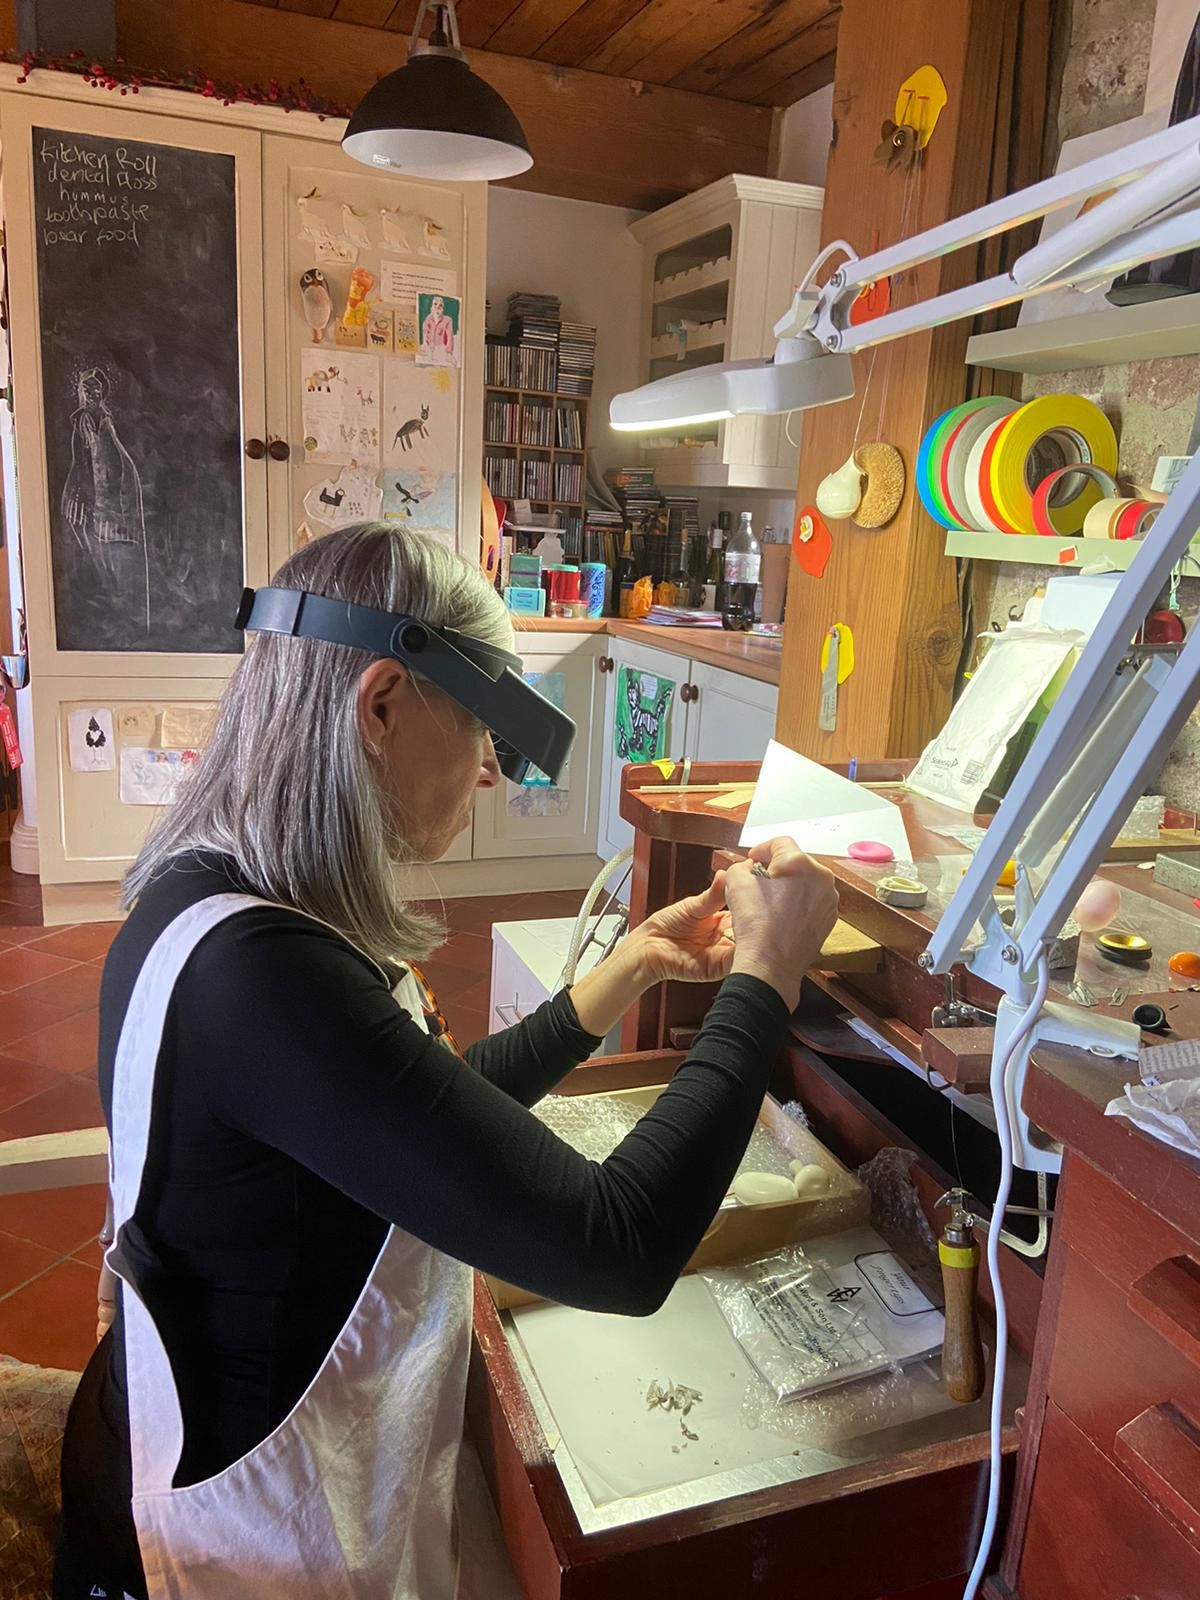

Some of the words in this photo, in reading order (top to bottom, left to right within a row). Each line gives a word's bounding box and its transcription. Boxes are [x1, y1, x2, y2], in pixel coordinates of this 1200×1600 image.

[48, 161, 110, 186] dental
[116, 171, 157, 190] floss
[116, 147, 157, 178] Roll
[60, 182, 129, 205] hummus
[46, 202, 149, 225] toothpaste
[96, 221, 140, 248] food
[815, 1308, 828, 1324] Son
[825, 1321, 838, 1336] Ltd
